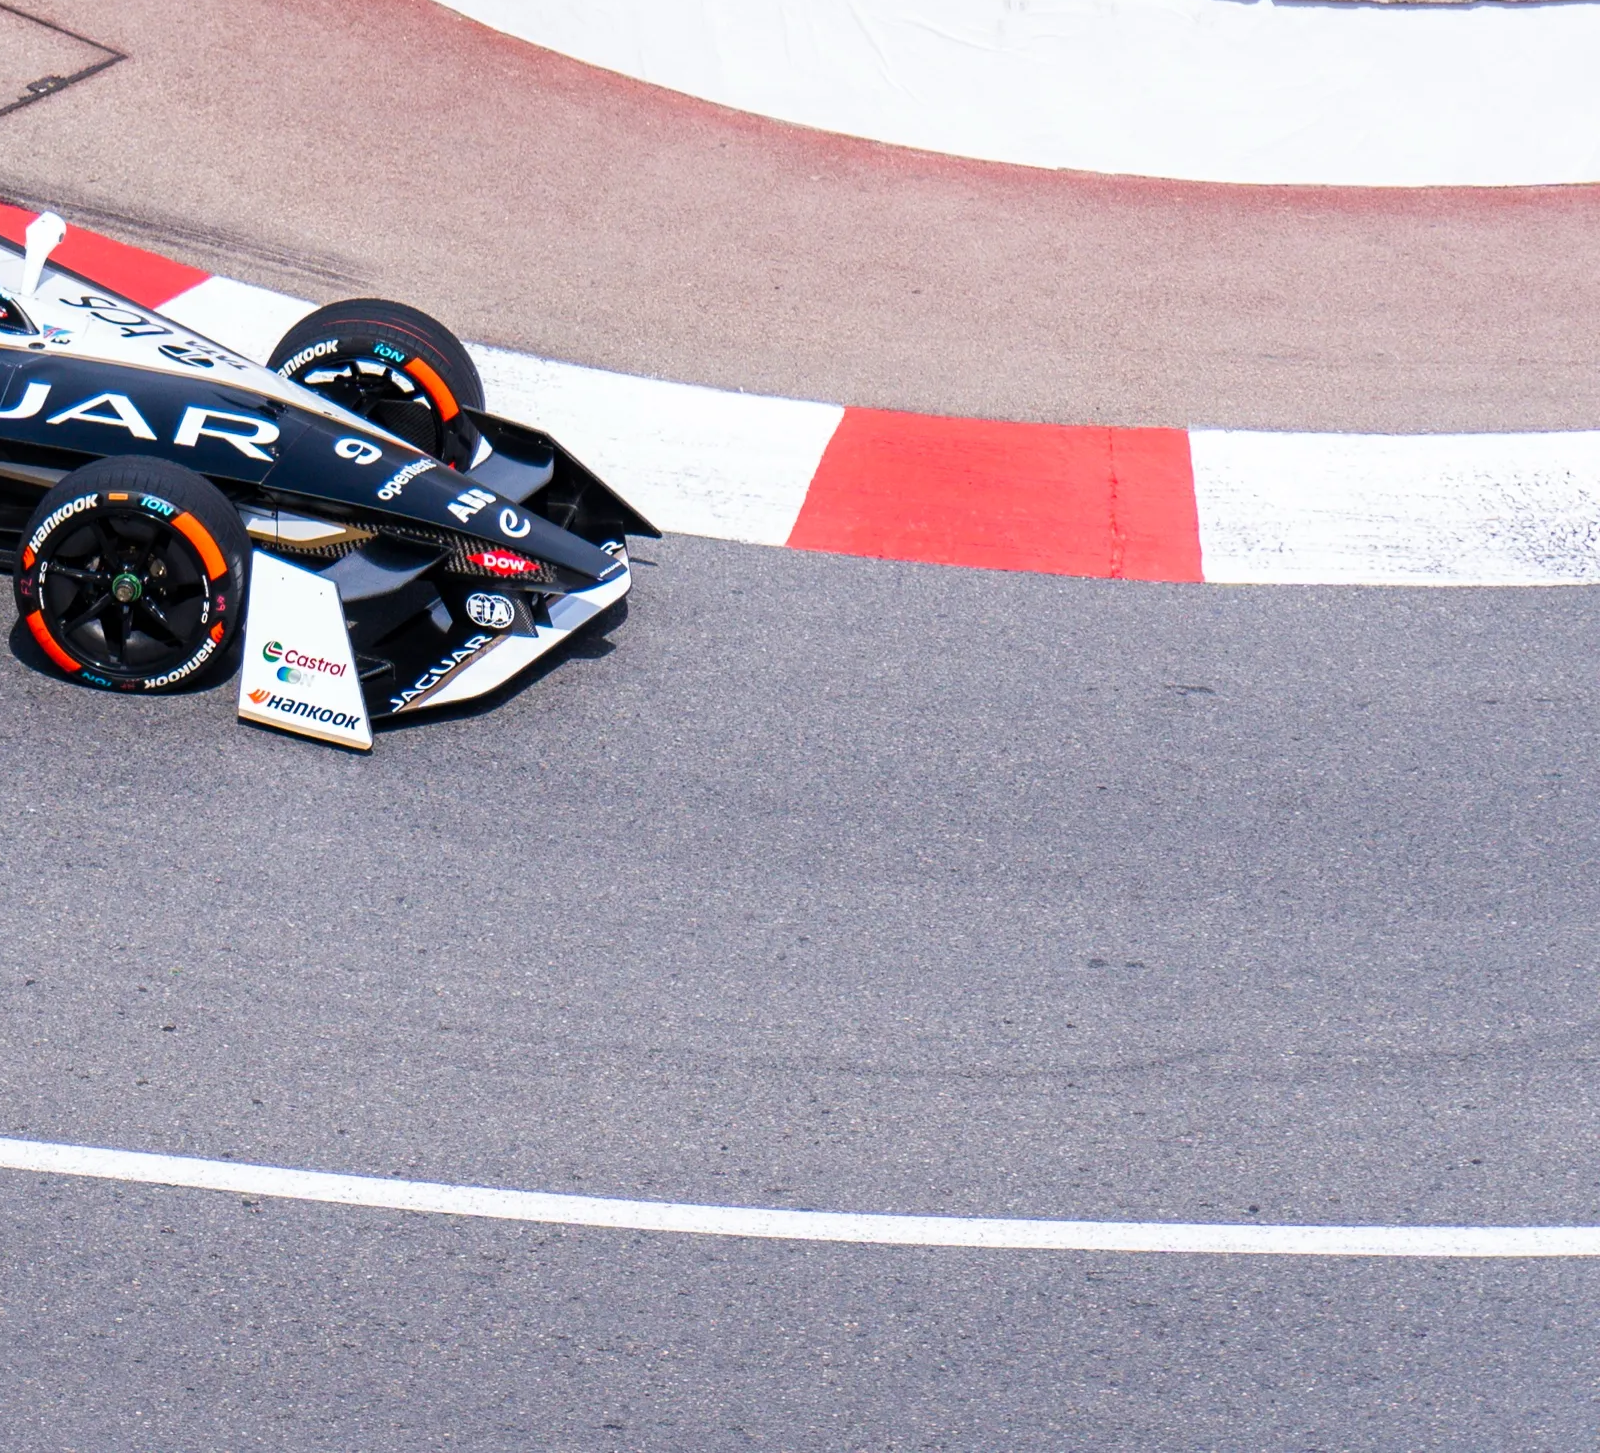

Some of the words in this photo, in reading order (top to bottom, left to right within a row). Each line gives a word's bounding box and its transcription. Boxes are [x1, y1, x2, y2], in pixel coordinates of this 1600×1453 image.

[334, 438, 383, 465] 9
[447, 488, 497, 524] ABB
[284, 649, 347, 678] Castrol
[388, 633, 493, 714] JAGUAR
